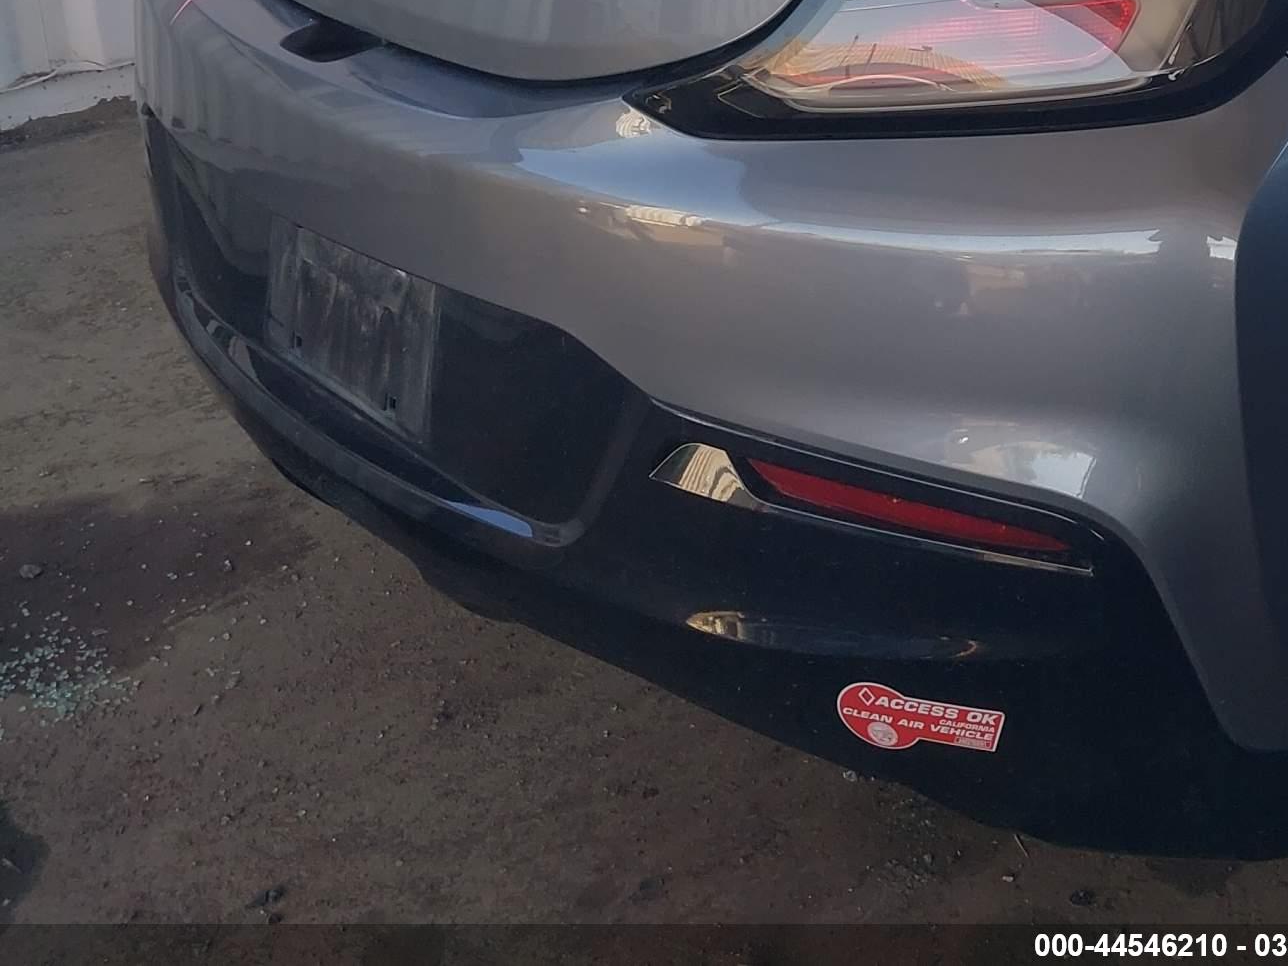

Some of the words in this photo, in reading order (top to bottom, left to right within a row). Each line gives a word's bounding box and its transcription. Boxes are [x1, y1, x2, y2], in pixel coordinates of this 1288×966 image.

[843, 707, 893, 724] CLEAN
[897, 719, 924, 730] AIR
[930, 724, 994, 741] VEHICLE
[875, 696, 959, 719] ACCESS
[967, 712, 996, 725] OK
[939, 719, 995, 733] CALIFORNIA
